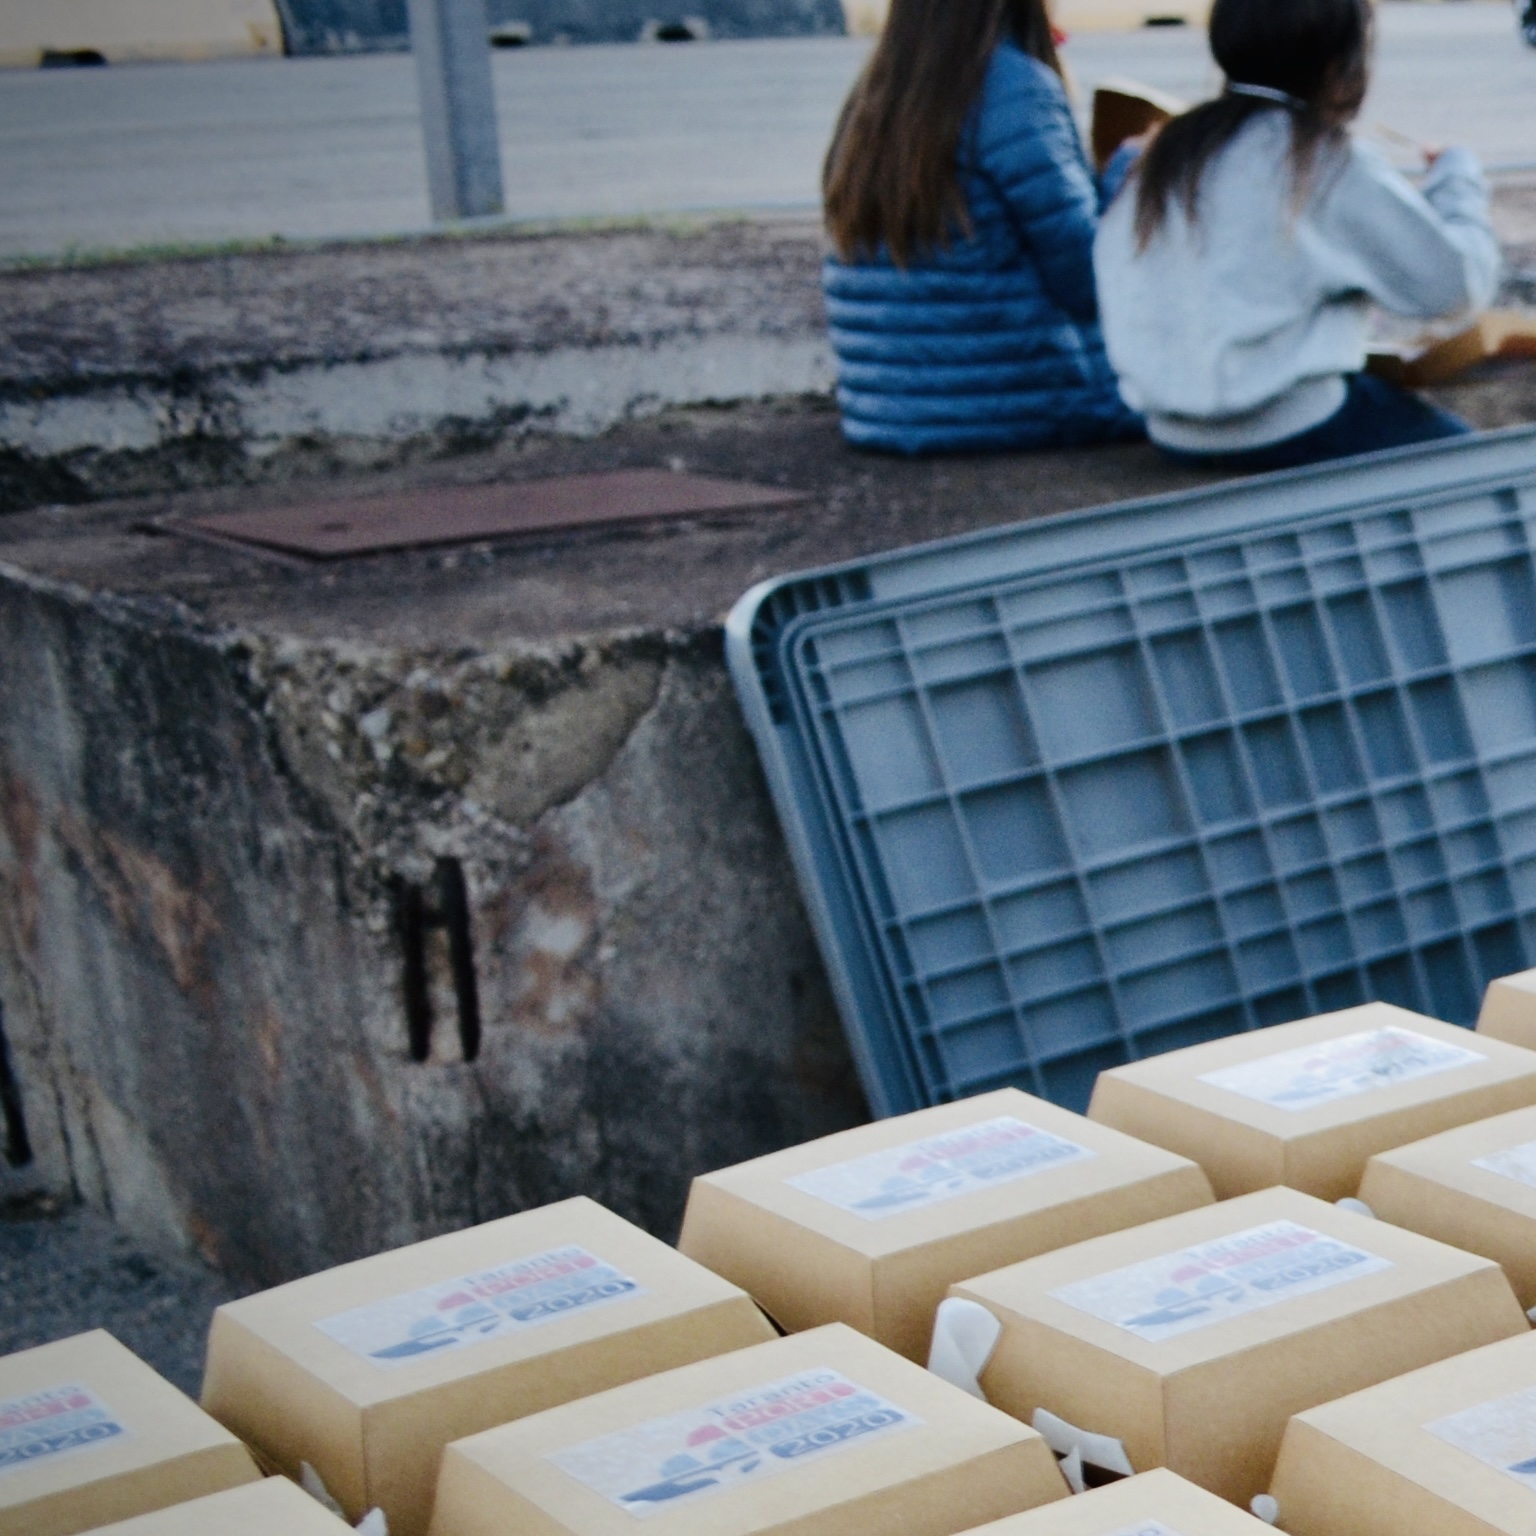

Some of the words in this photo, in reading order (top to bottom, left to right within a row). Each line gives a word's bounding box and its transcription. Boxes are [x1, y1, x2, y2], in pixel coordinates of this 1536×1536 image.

[1272, 1253, 1356, 1287] 2020
[526, 1281, 625, 1319] 2020
[712, 1376, 836, 1417] Taranto
[786, 1411, 894, 1456] 2020
